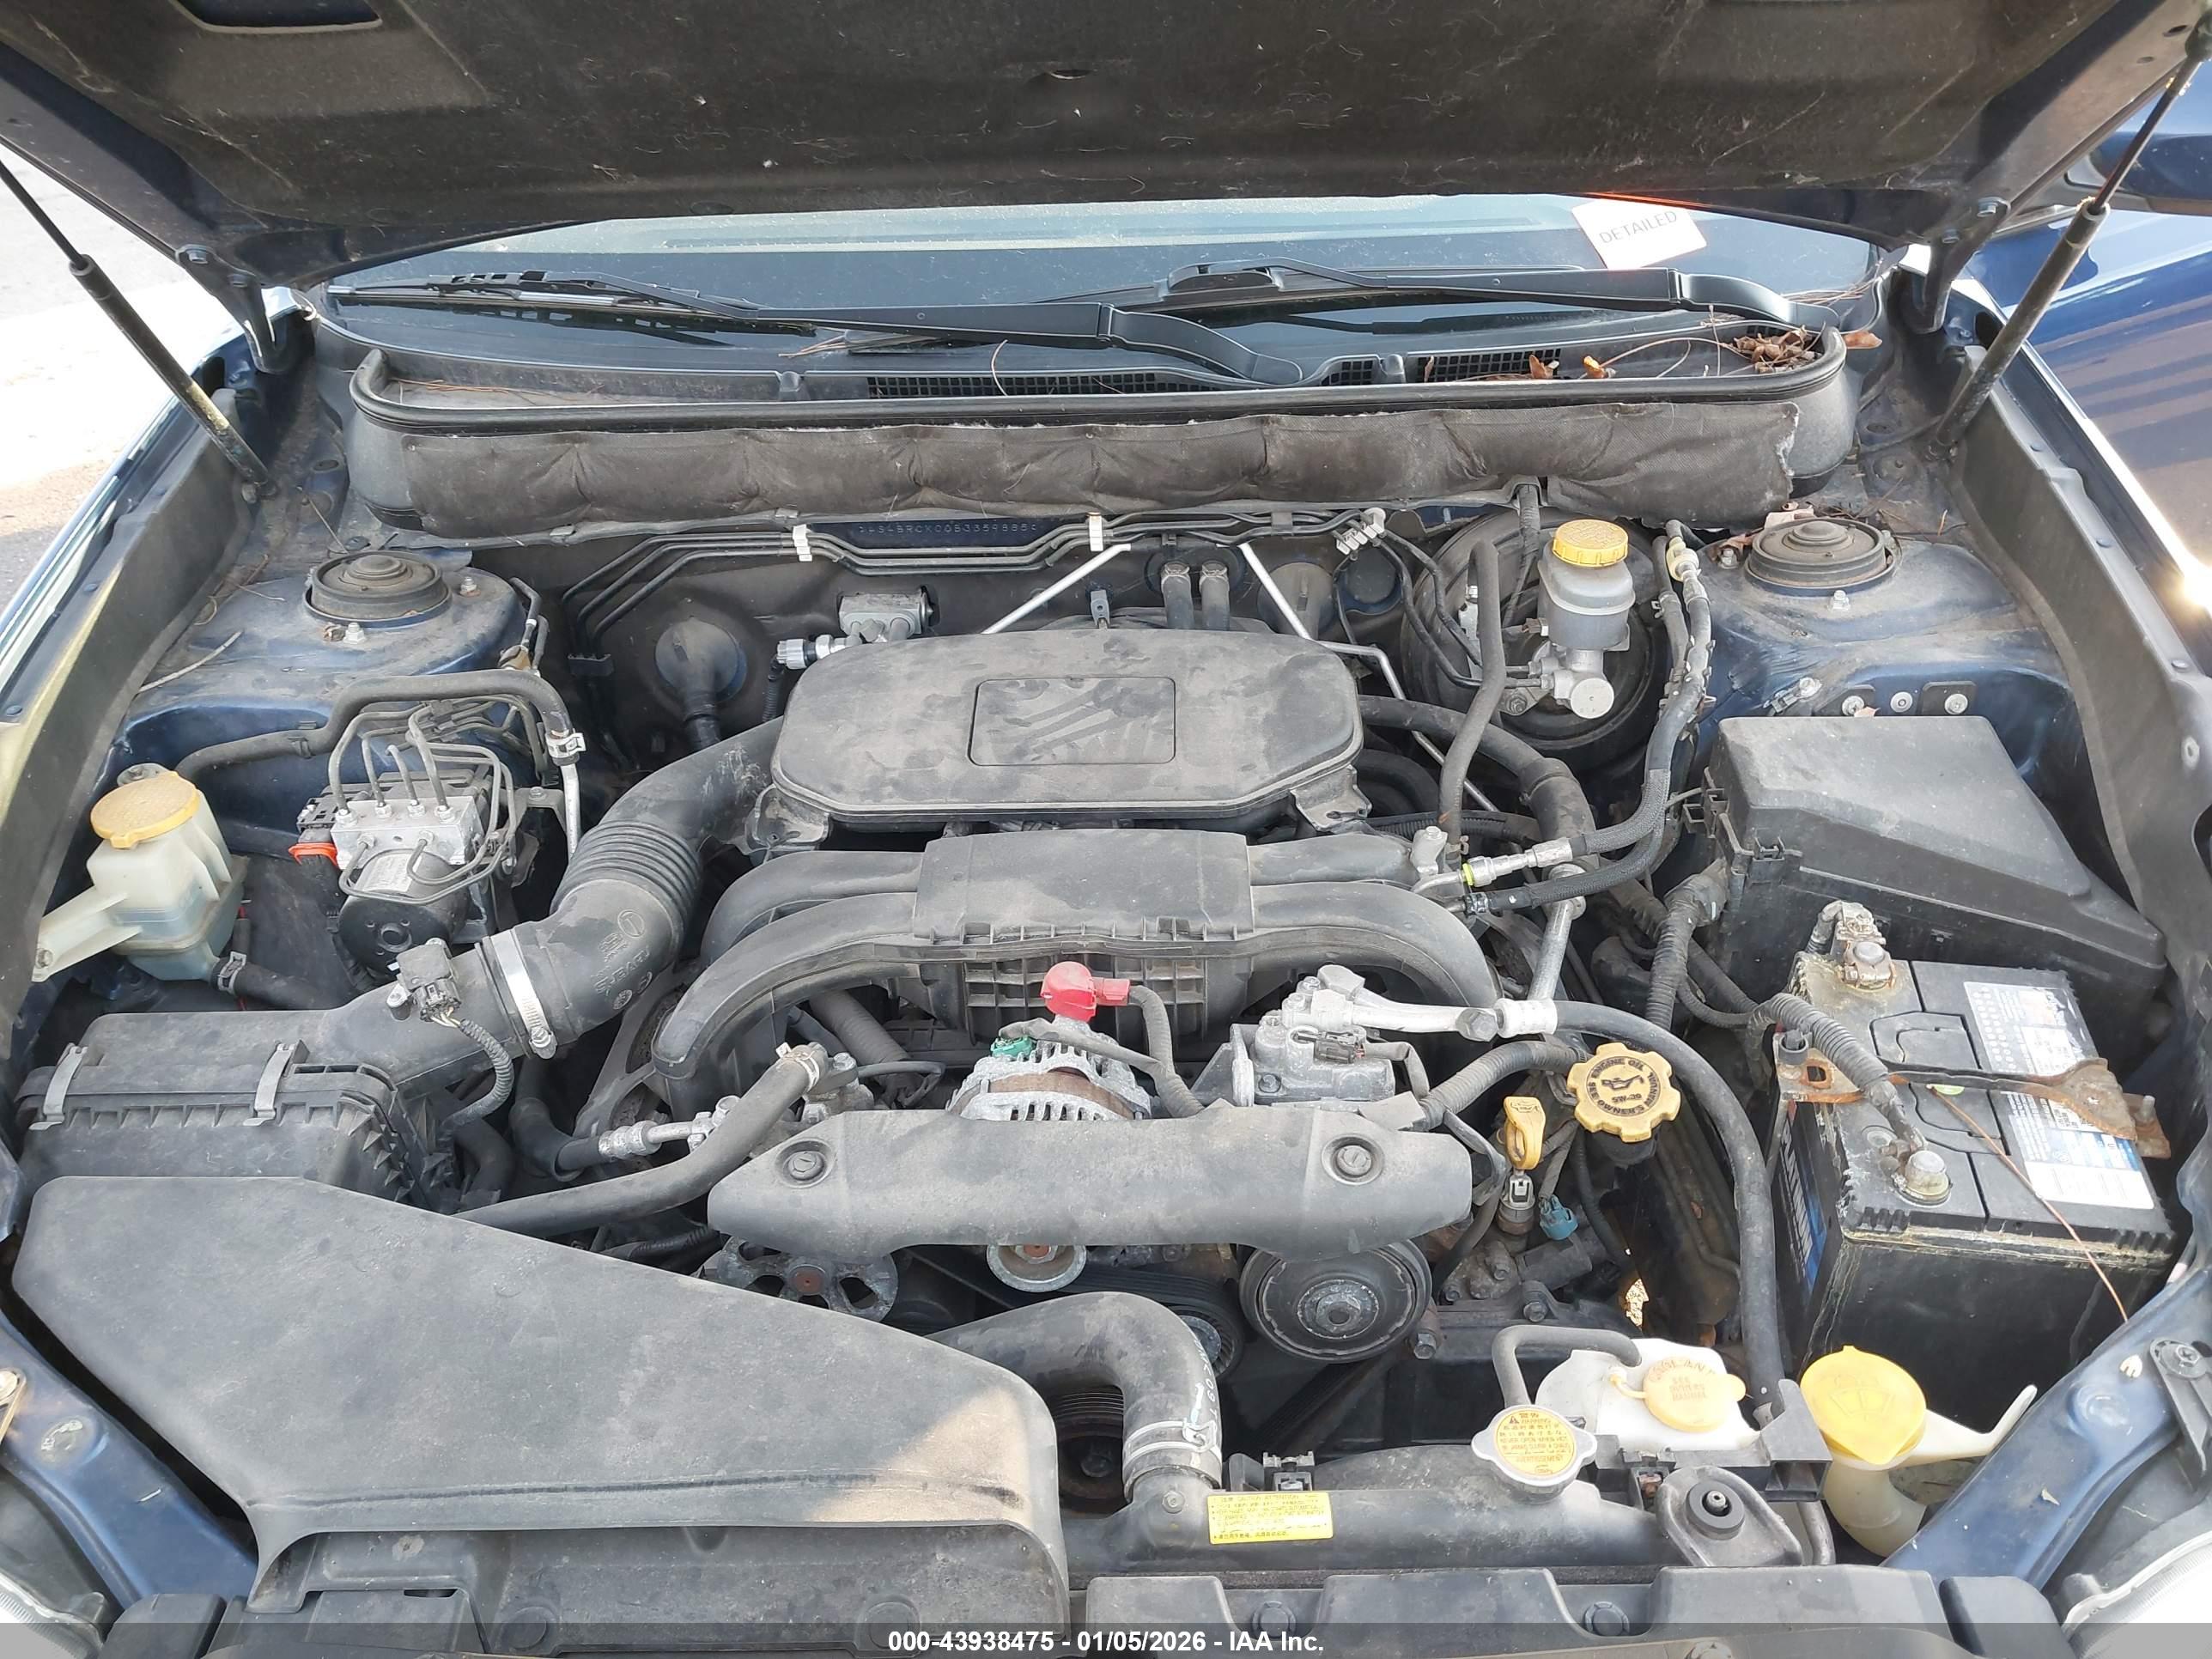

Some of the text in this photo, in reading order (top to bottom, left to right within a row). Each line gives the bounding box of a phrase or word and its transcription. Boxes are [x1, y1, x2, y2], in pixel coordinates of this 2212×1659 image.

[1599, 210, 1677, 244] DETAILED
[1591, 1058, 1644, 1079] ENGINE OIL
[1588, 1081, 1600, 1098] SEE
[1644, 1072, 1658, 1108] MANUAL
